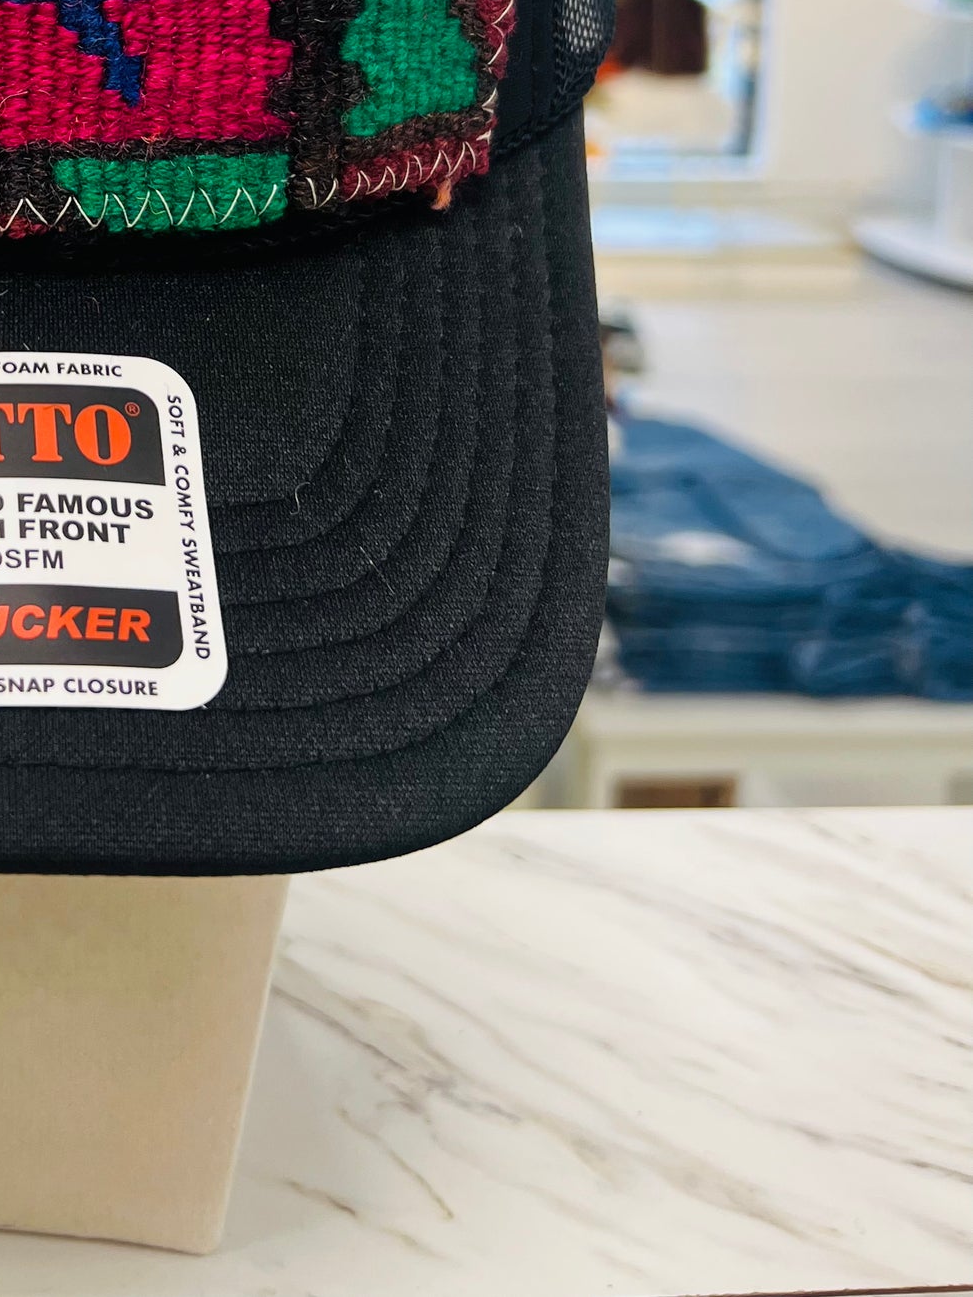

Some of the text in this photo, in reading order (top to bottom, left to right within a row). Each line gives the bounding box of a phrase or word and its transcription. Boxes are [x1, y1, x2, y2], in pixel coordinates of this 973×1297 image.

[57, 363, 122, 377] FABRIC
[17, 493, 154, 520] FAMOUS
[19, 519, 130, 543] FRONT
[167, 395, 210, 660] SOFT & COMFY SWEATBAND
[64, 679, 158, 696] CLOSURE
